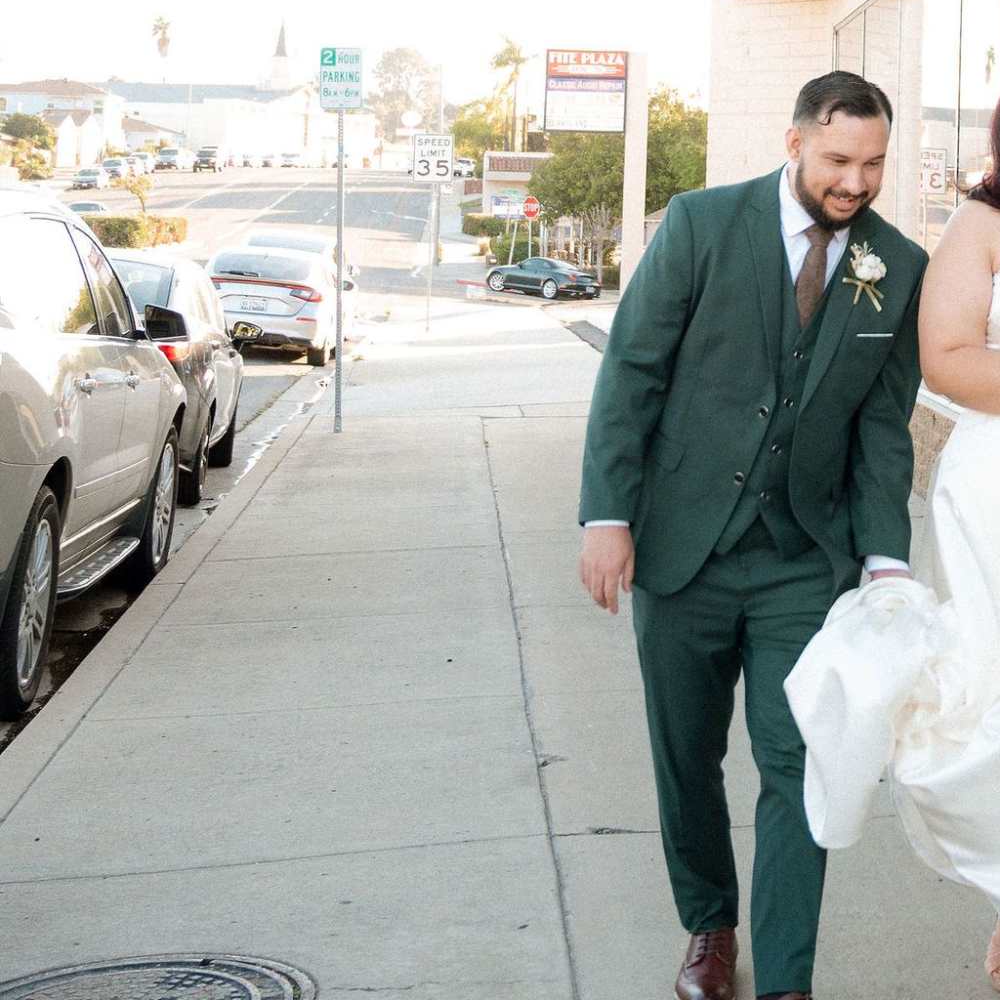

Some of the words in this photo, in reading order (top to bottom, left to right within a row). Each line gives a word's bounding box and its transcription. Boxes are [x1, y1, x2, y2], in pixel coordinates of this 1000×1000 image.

[322, 51, 334, 65] 2
[338, 54, 360, 64] HOUR
[581, 53, 625, 65] PLAZA
[322, 71, 360, 83] PARKING
[417, 138, 450, 147] SPEED
[421, 149, 446, 157] LIMIT
[417, 159, 449, 177] 35
[525, 203, 538, 212] STOP
